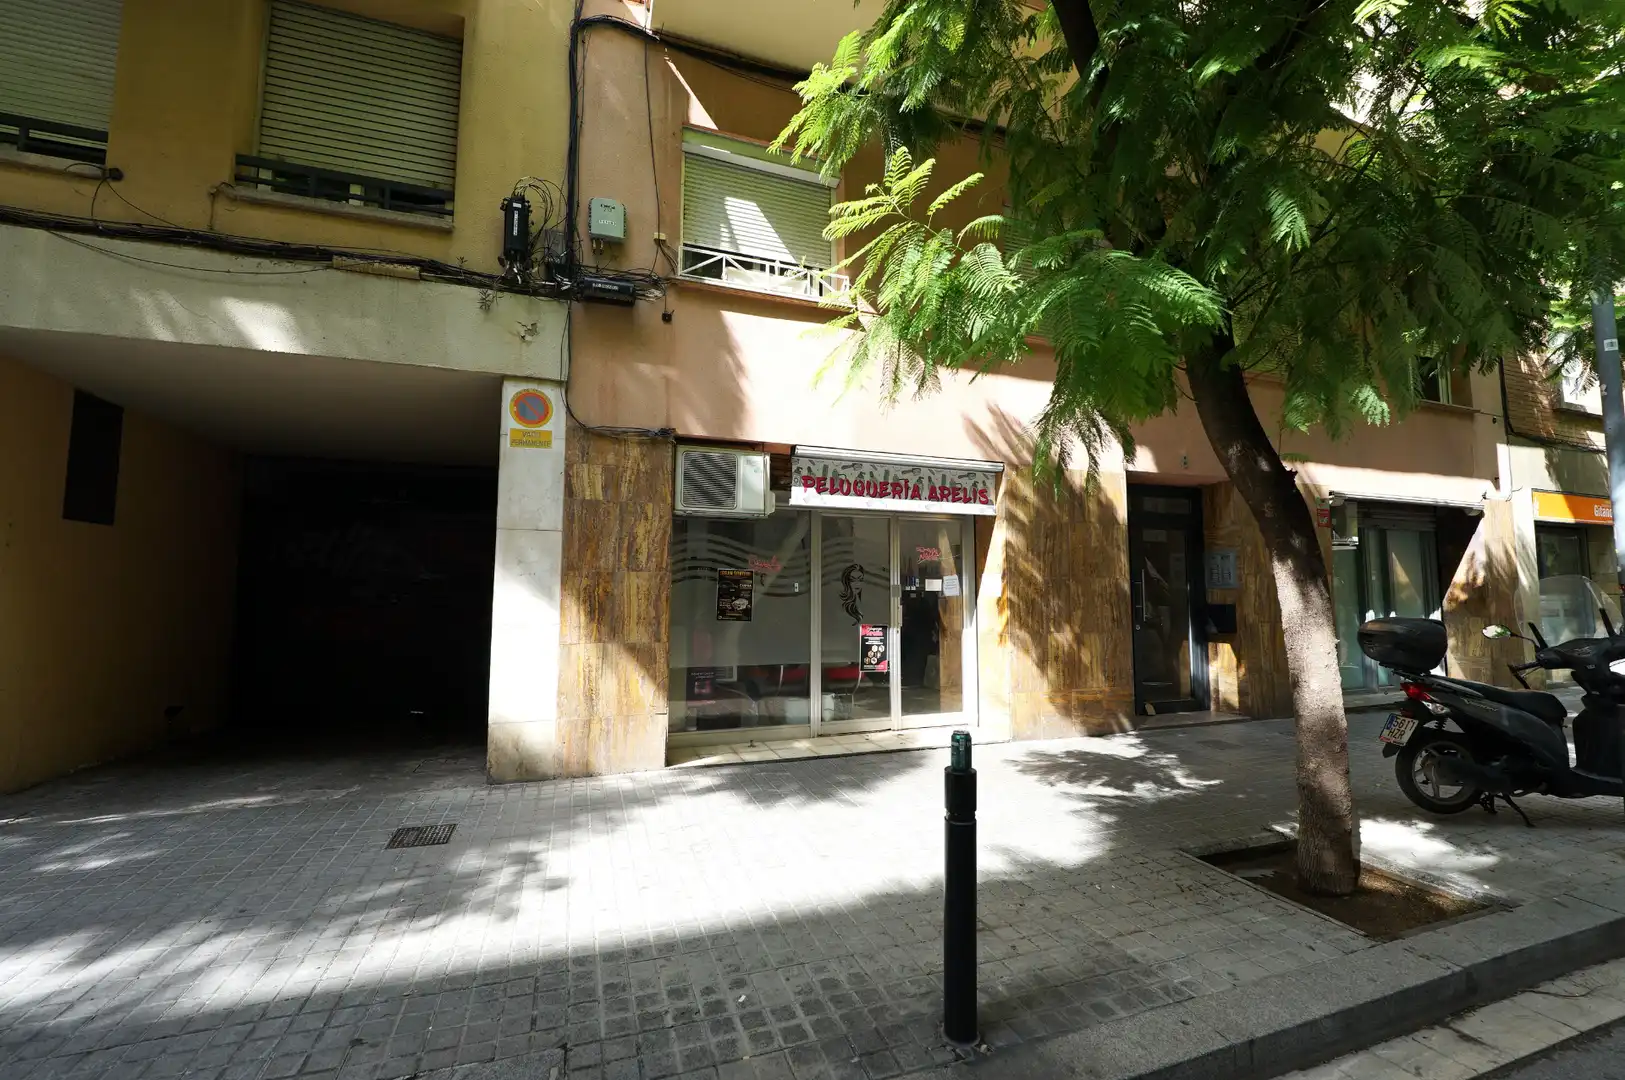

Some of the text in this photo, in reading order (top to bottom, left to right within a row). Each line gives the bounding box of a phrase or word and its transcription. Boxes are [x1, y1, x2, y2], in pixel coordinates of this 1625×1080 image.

[801, 475, 990, 505] PELUQUERÍA ARELIS
[1387, 729, 1406, 740] HZR
